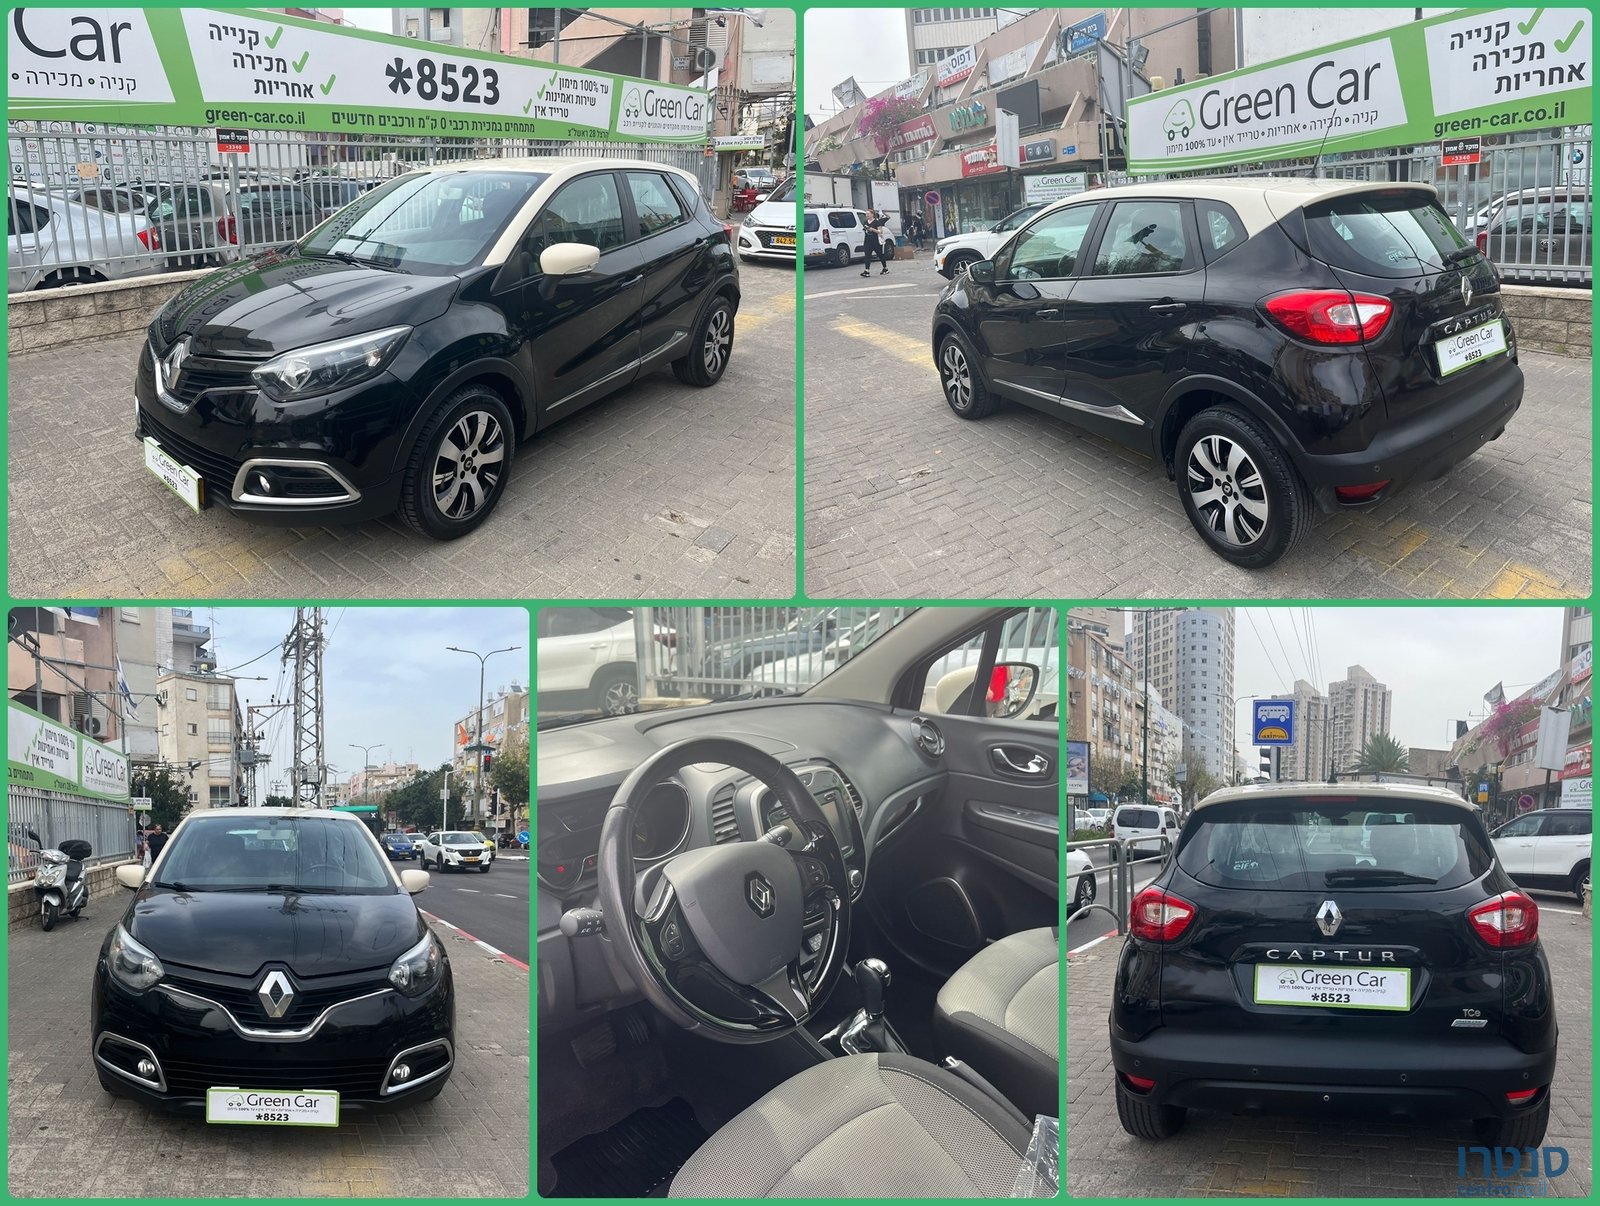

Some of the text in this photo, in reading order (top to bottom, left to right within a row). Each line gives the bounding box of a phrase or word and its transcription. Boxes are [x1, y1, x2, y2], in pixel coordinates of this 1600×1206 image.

[14, 8, 132, 64] Car
[209, 23, 260, 50] קנייה
[1450, 21, 1510, 50] קנייה
[233, 52, 287, 73] מכירה
[1473, 42, 1545, 71] מכירה
[26, 71, 137, 95] קניה מכירה
[559, 77, 609, 95] עד 100% מימון
[1494, 62, 1586, 94] אחריות
[254, 79, 314, 99] אחריות
[545, 91, 597, 107] שירות ואמינות
[1200, 61, 1381, 130] Green Car
[535, 105, 569, 119] טרייד אין
[644, 89, 704, 121] Green Car
[205, 109, 305, 125] green-car.co.il
[332, 112, 375, 126] חדשים
[379, 114, 415, 128] ורכבים
[440, 118, 447, 130] 0
[449, 119, 470, 131] רכבי
[472, 120, 503, 132] במכירת
[1434, 102, 1565, 137] green-car.co.il
[505, 122, 535, 133] מתמחים
[1166, 110, 1379, 156] קניה מכירה אחריות טרייד אין עד 100% מימון
[1042, 175, 1078, 186] Green Car
[1444, 310, 1497, 335] CAPTUR
[1456, 328, 1494, 349] Green Car
[159, 454, 190, 487] Green Car
[94, 749, 126, 782] Green Car
[1266, 950, 1396, 962] CAPTUR
[1301, 969, 1387, 988] Green Car
[1463, 1009, 1481, 1017] TCe
[247, 1094, 320, 1108] Green Car
